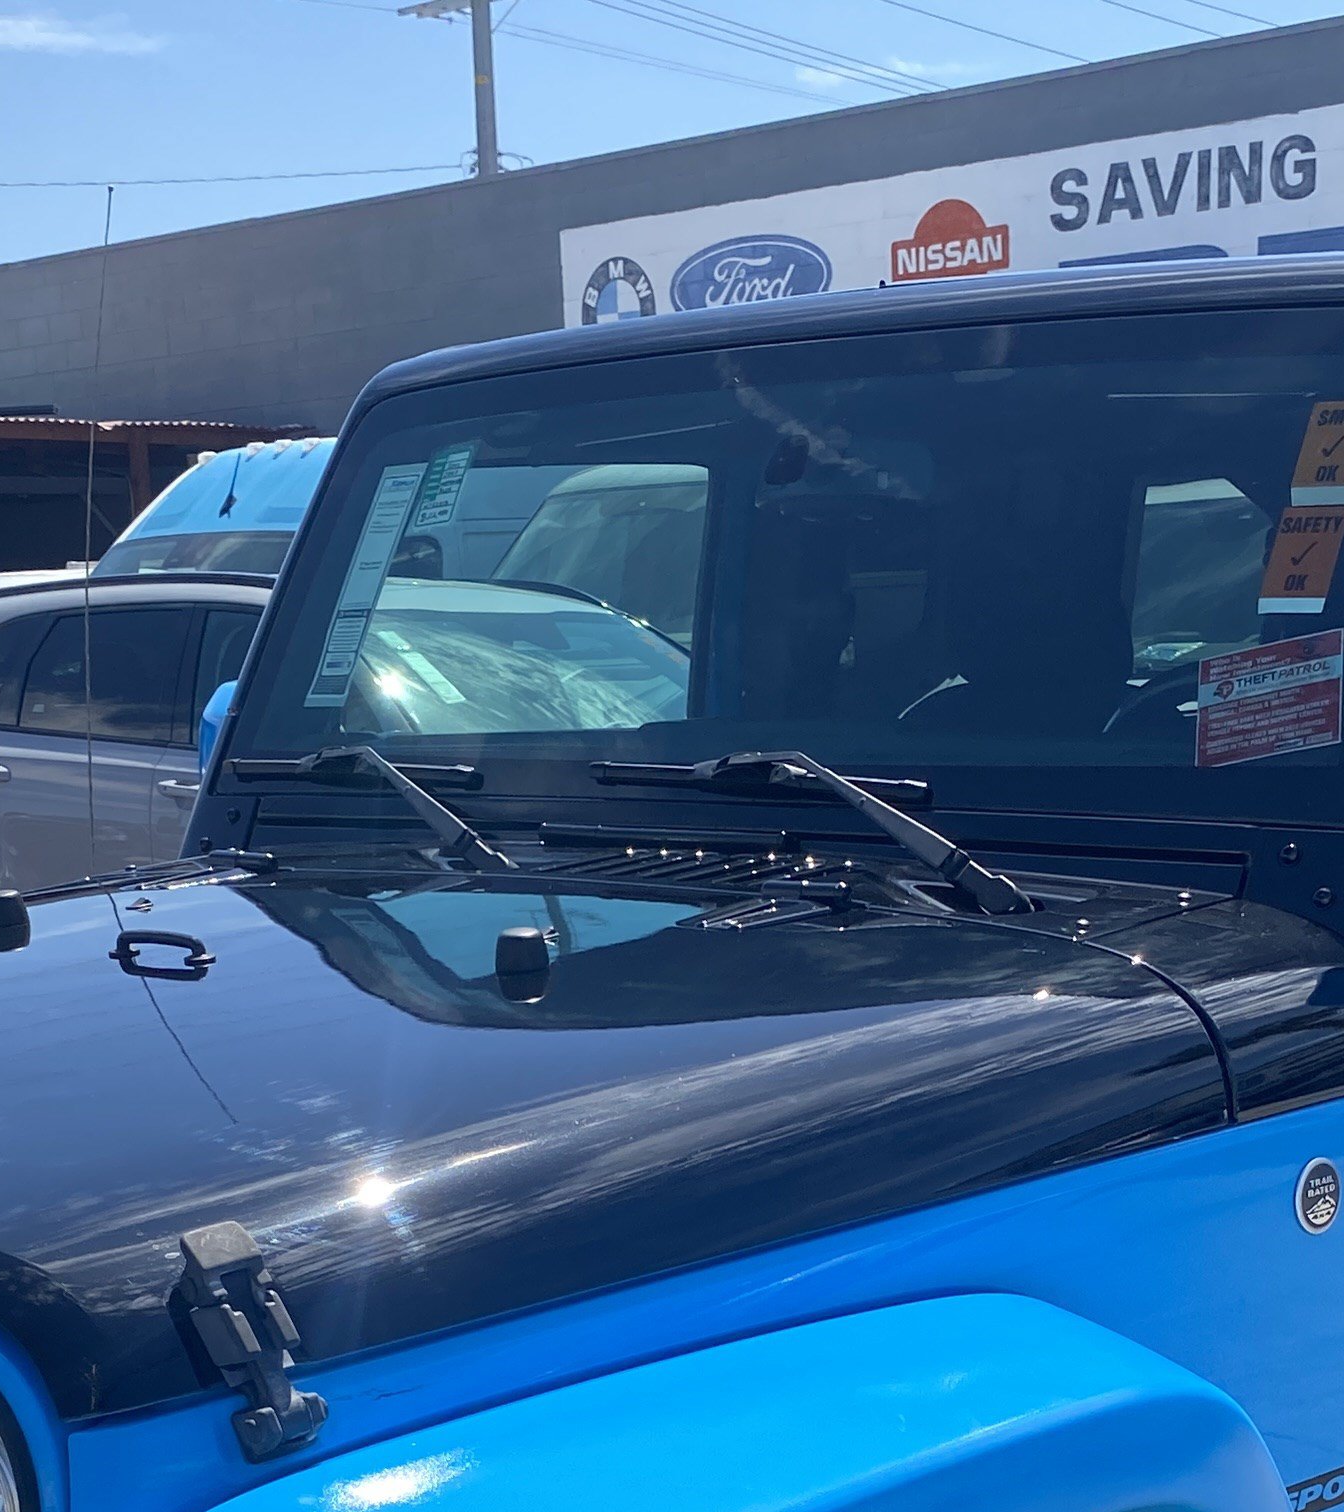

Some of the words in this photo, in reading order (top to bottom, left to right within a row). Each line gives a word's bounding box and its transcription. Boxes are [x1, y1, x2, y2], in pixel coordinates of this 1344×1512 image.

[1049, 133, 1317, 232] SAVING
[896, 234, 1003, 275] NISSAN
[704, 256, 795, 305] Ford
[1315, 465, 1339, 482] OK
[1281, 515, 1343, 535] SAFETY
[1284, 573, 1309, 592] OK
[1307, 1183, 1336, 1198] RATED
